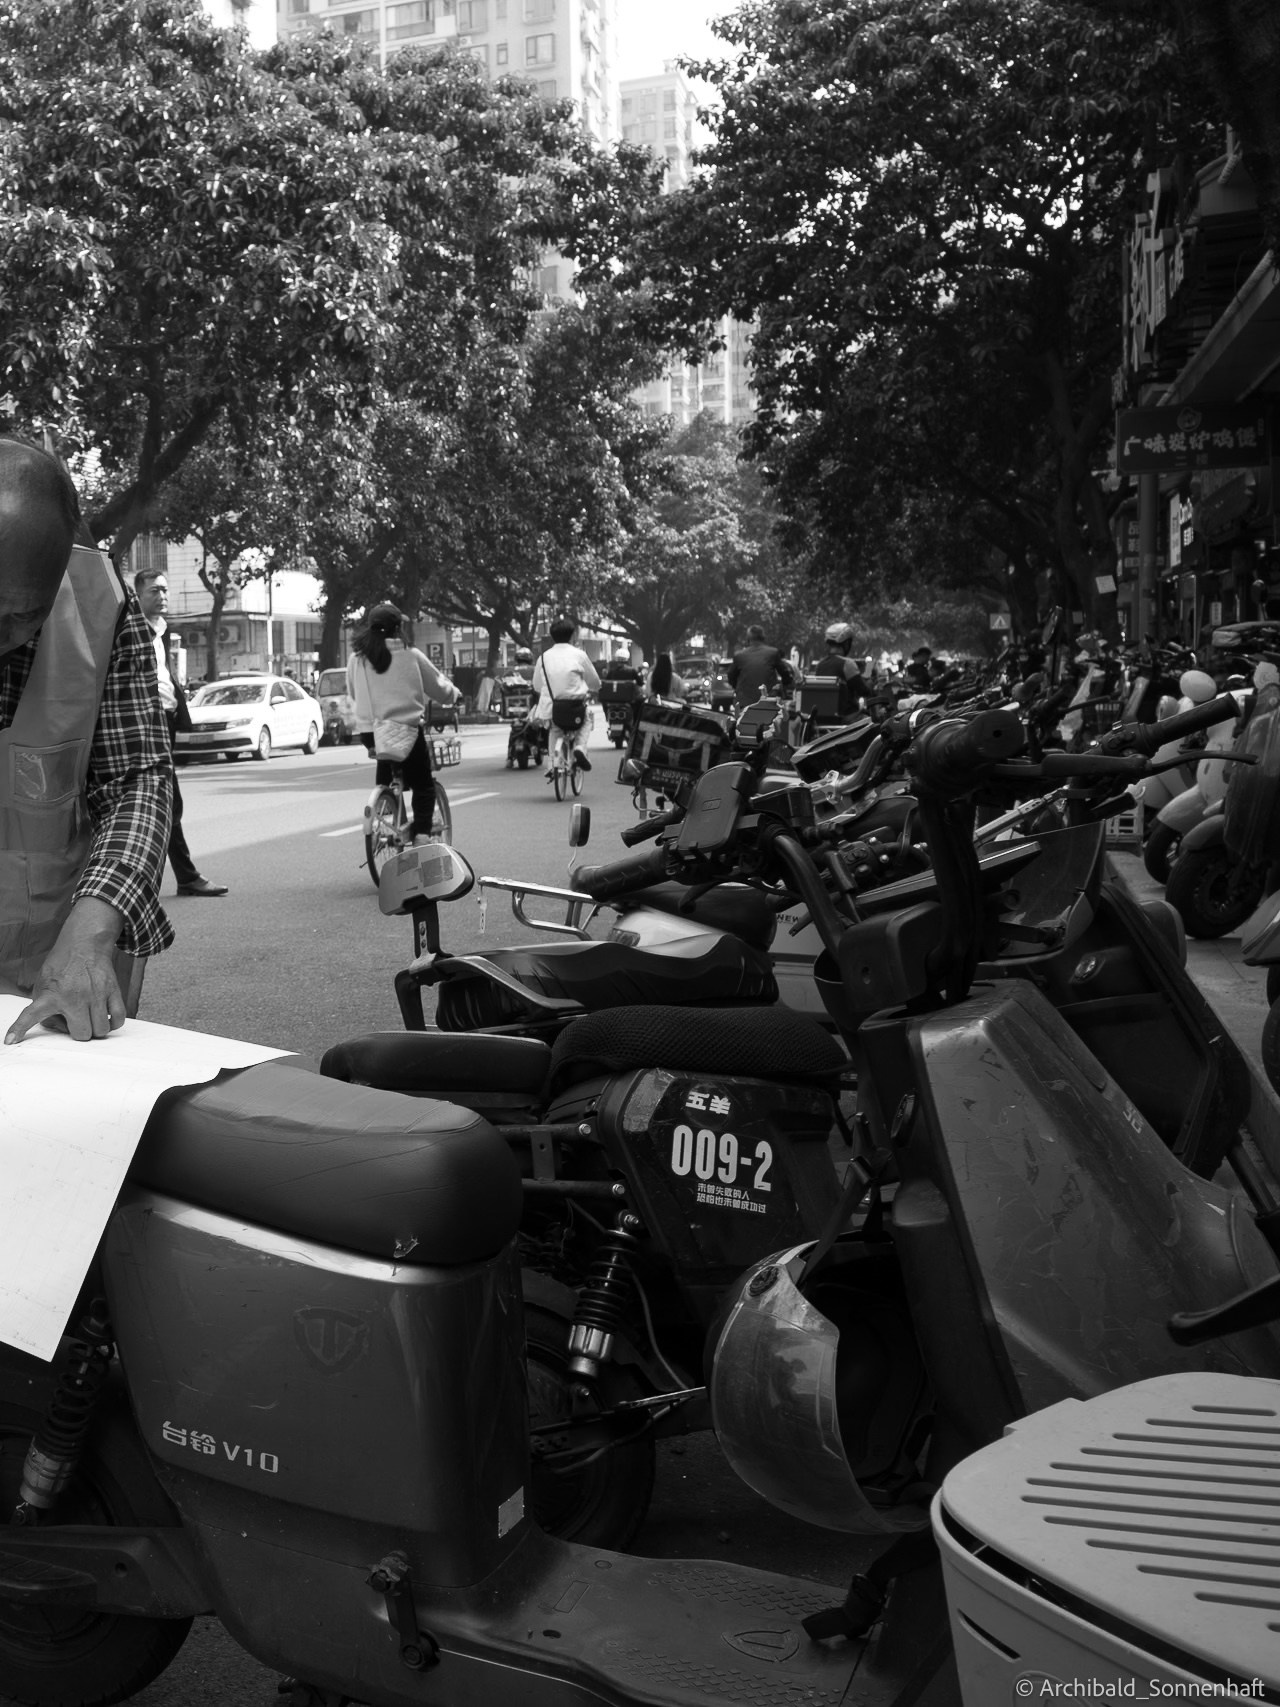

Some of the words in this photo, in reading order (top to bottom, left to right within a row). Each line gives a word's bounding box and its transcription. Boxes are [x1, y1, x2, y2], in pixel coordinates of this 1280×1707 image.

[430, 644, 440, 657] P
[671, 1124, 773, 1191] 009-2
[697, 1182, 750, 1201] 未曾失败的人
[696, 1192, 767, 1214] 恐怕也未曾成功过
[222, 1440, 279, 1474] V10
